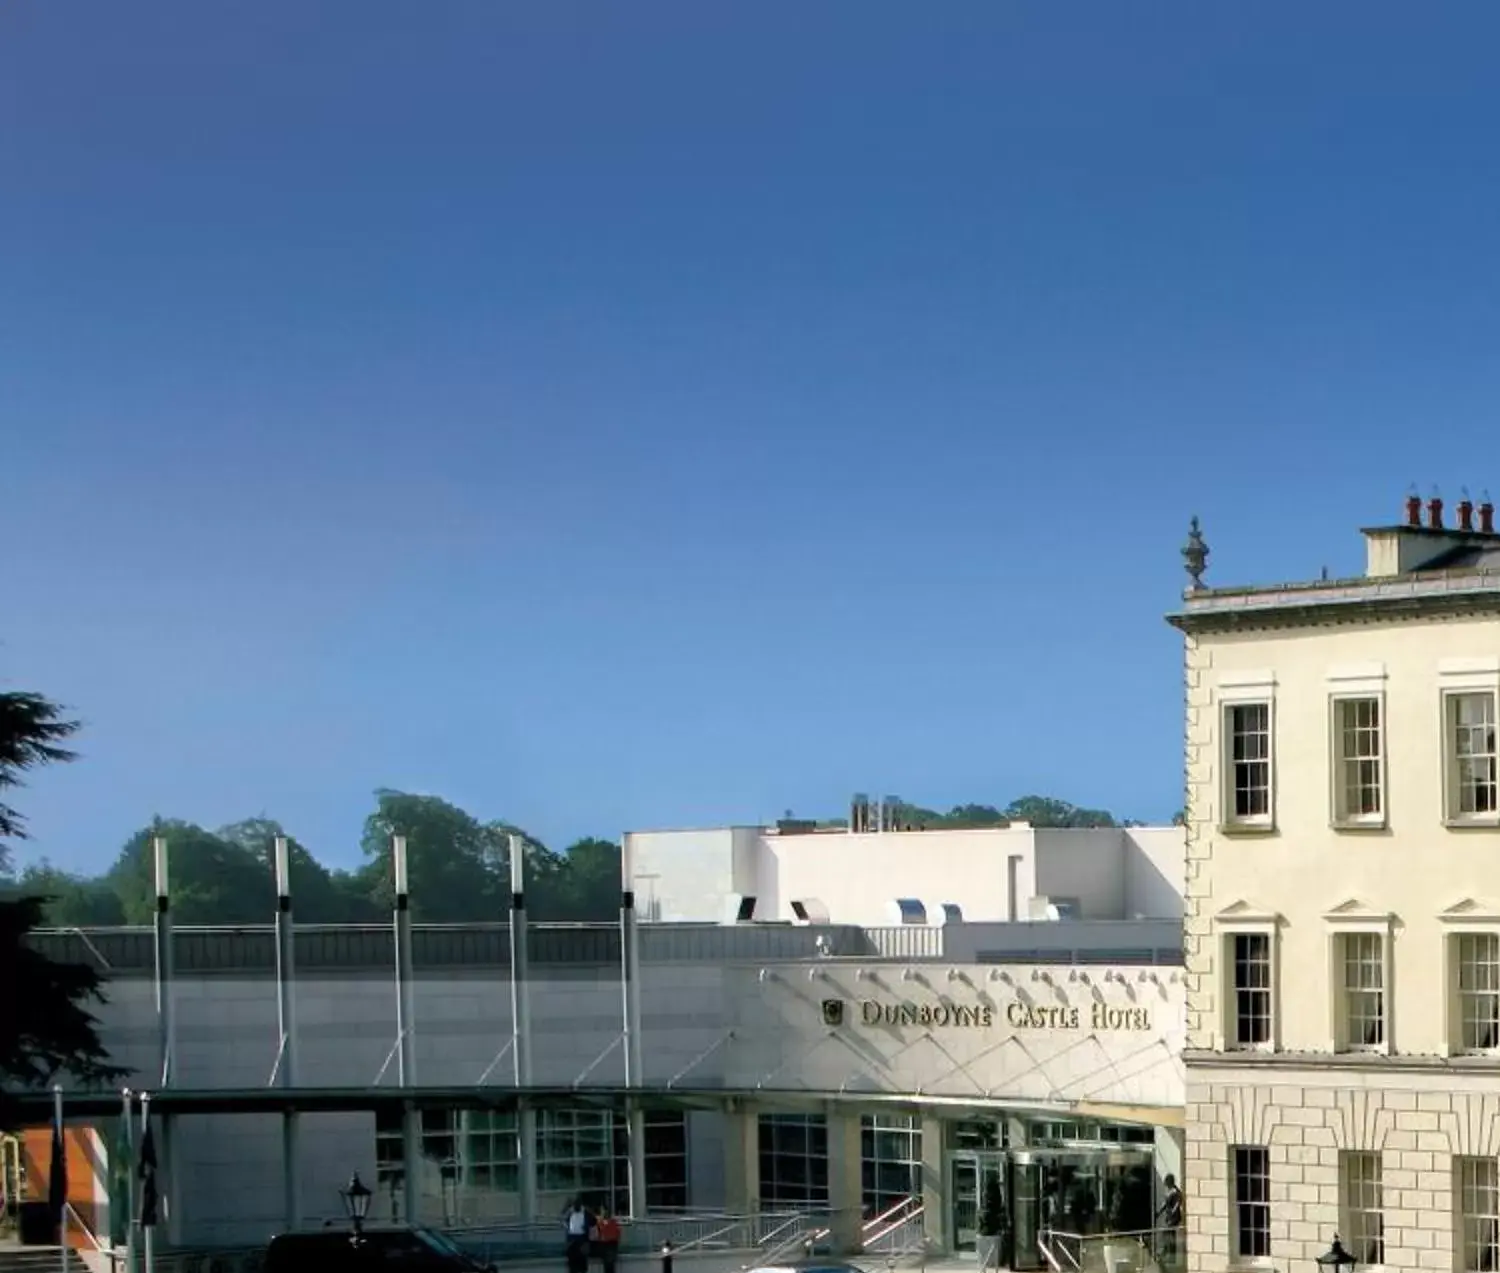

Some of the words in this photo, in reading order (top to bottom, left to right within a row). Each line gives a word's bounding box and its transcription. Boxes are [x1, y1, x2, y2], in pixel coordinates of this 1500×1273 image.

[861, 999, 992, 1028] DUNBOYNE
[1006, 1002, 1080, 1029] CASTLE
[1091, 1001, 1151, 1031] HOTEL
